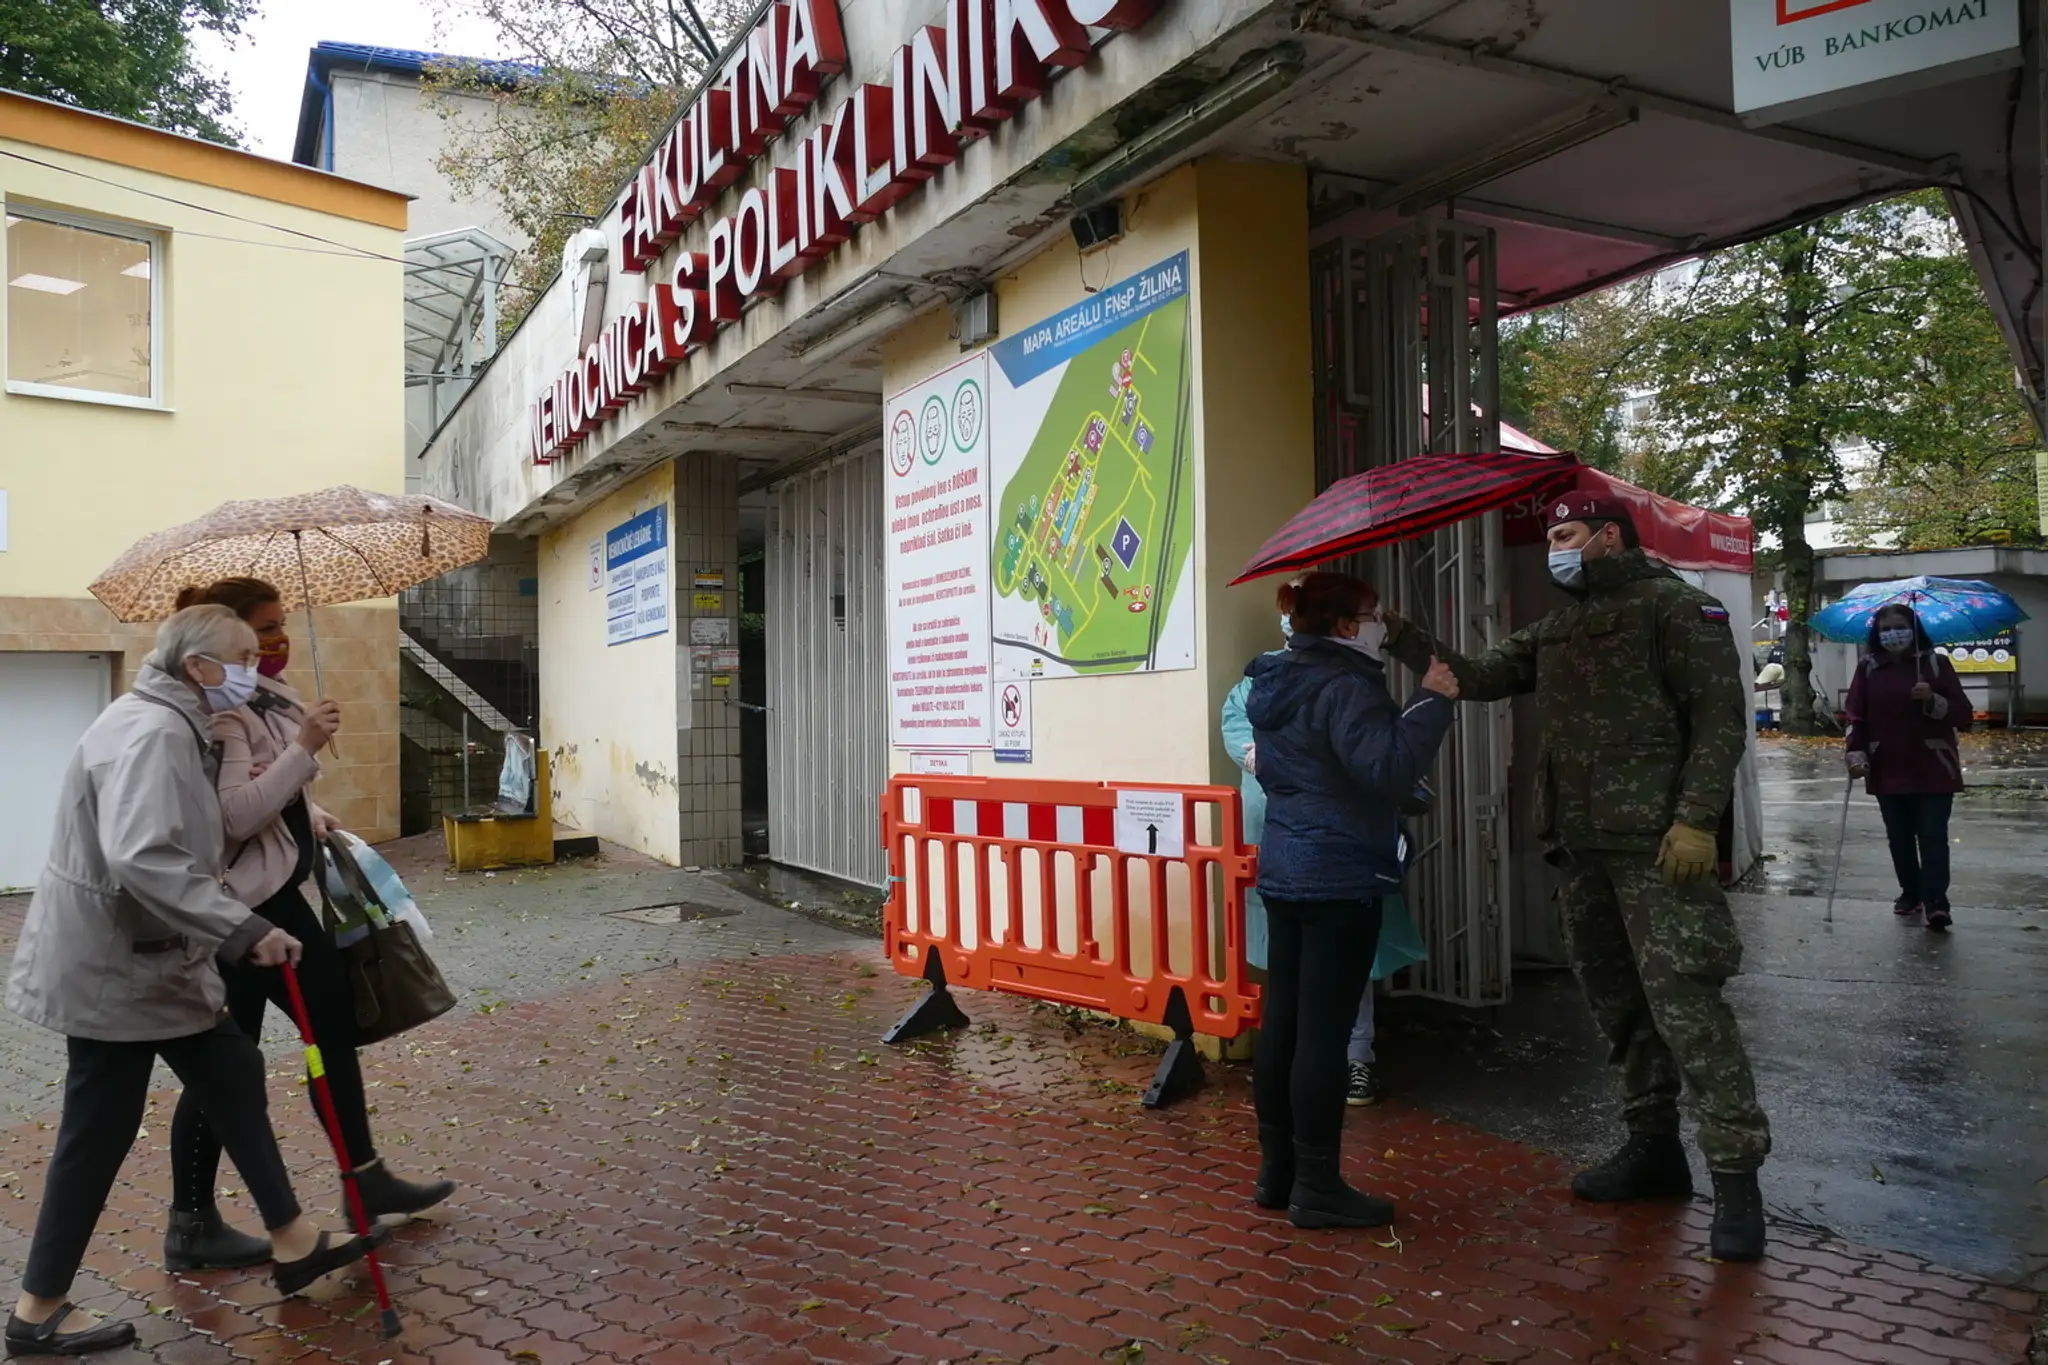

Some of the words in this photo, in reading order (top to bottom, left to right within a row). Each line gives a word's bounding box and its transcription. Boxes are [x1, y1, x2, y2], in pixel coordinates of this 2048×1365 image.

[1755, 44, 1806, 72] VÚB
[1825, 0, 1990, 57] BANKOMAT
[1022, 326, 1053, 356] MAPA
[1054, 301, 1101, 342] AREÁLU
[1104, 286, 1136, 318] FNsP
[1138, 264, 1182, 302] ŽILINA
[530, 284, 676, 466] NEMOCNICA
[671, 251, 702, 347] S
[1122, 534, 1131, 551] P
